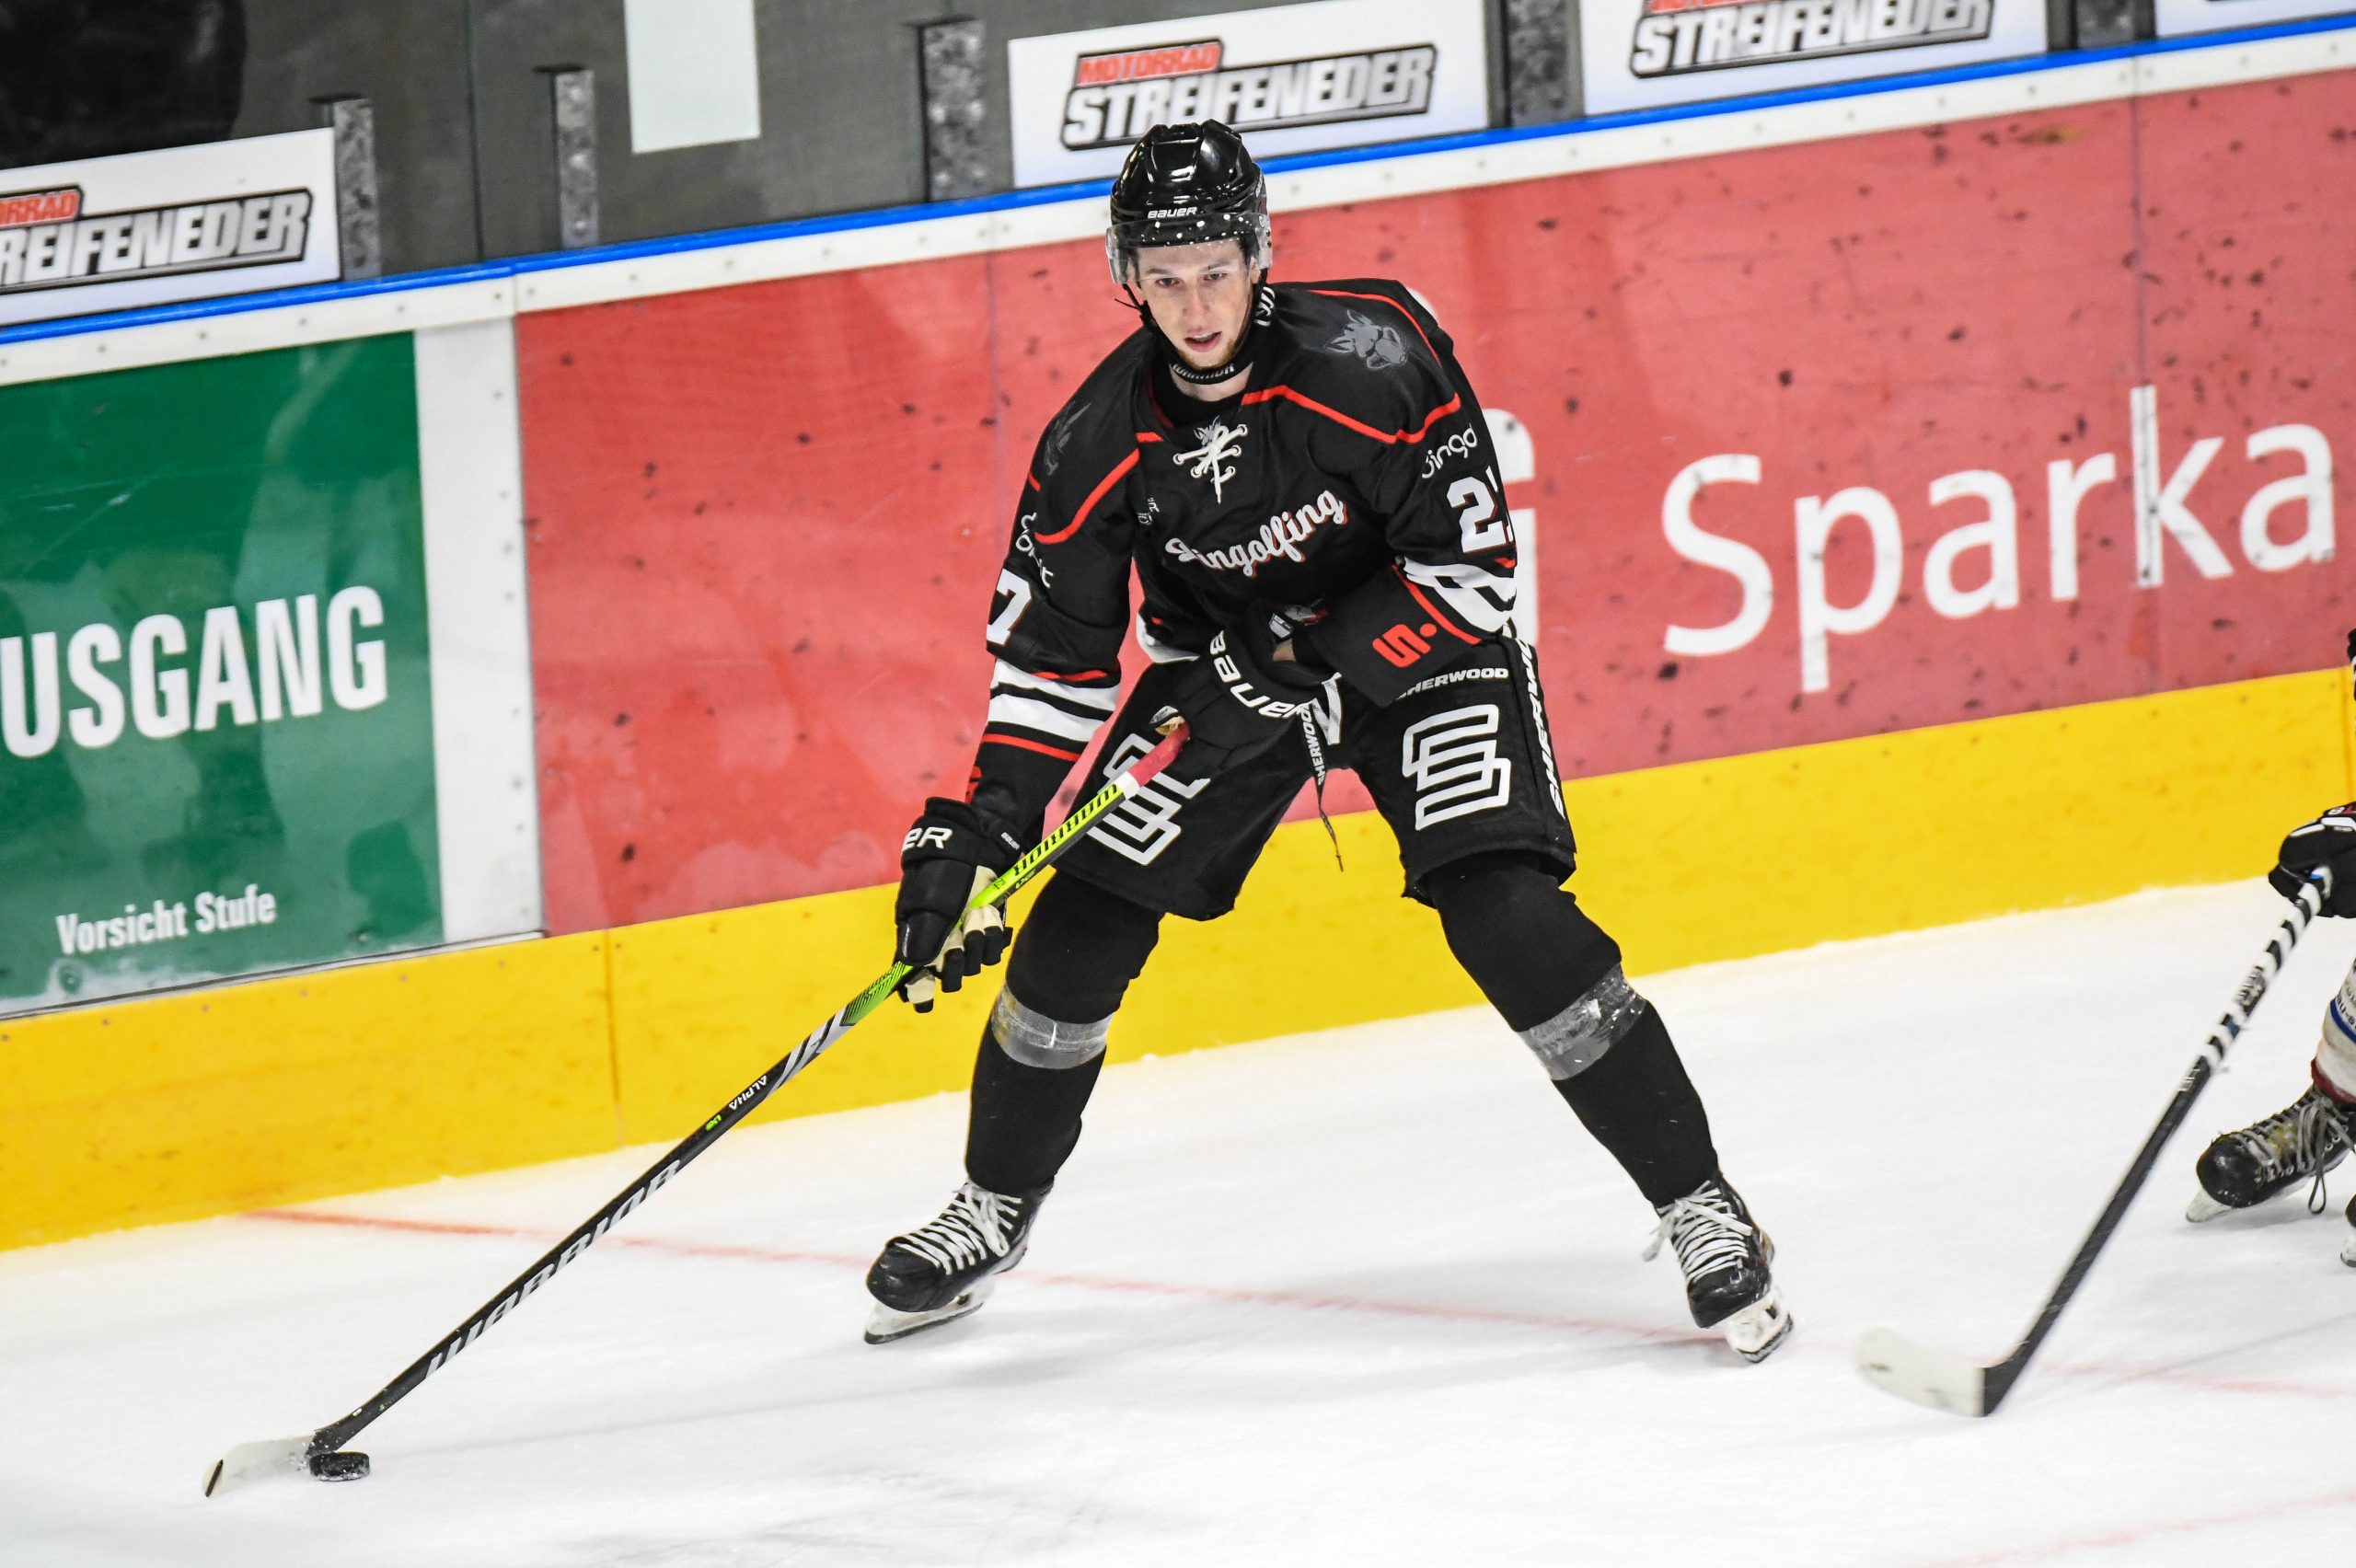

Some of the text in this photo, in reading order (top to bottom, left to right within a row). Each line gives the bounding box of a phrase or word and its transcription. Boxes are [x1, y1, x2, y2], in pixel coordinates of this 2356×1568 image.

[1063, 45, 1434, 145] STREIFENEDER
[1077, 41, 1222, 85] MOTORRAD
[1147, 206, 1197, 219] BAUER
[1446, 466, 1514, 553] 2
[1662, 385, 2338, 694] Sparka
[1395, 667, 1509, 700] HERWOOD
[1012, 782, 1118, 877] WARRIOR
[56, 882, 277, 954] Vorsicht Stufe
[728, 1075, 768, 1111] ALPHA
